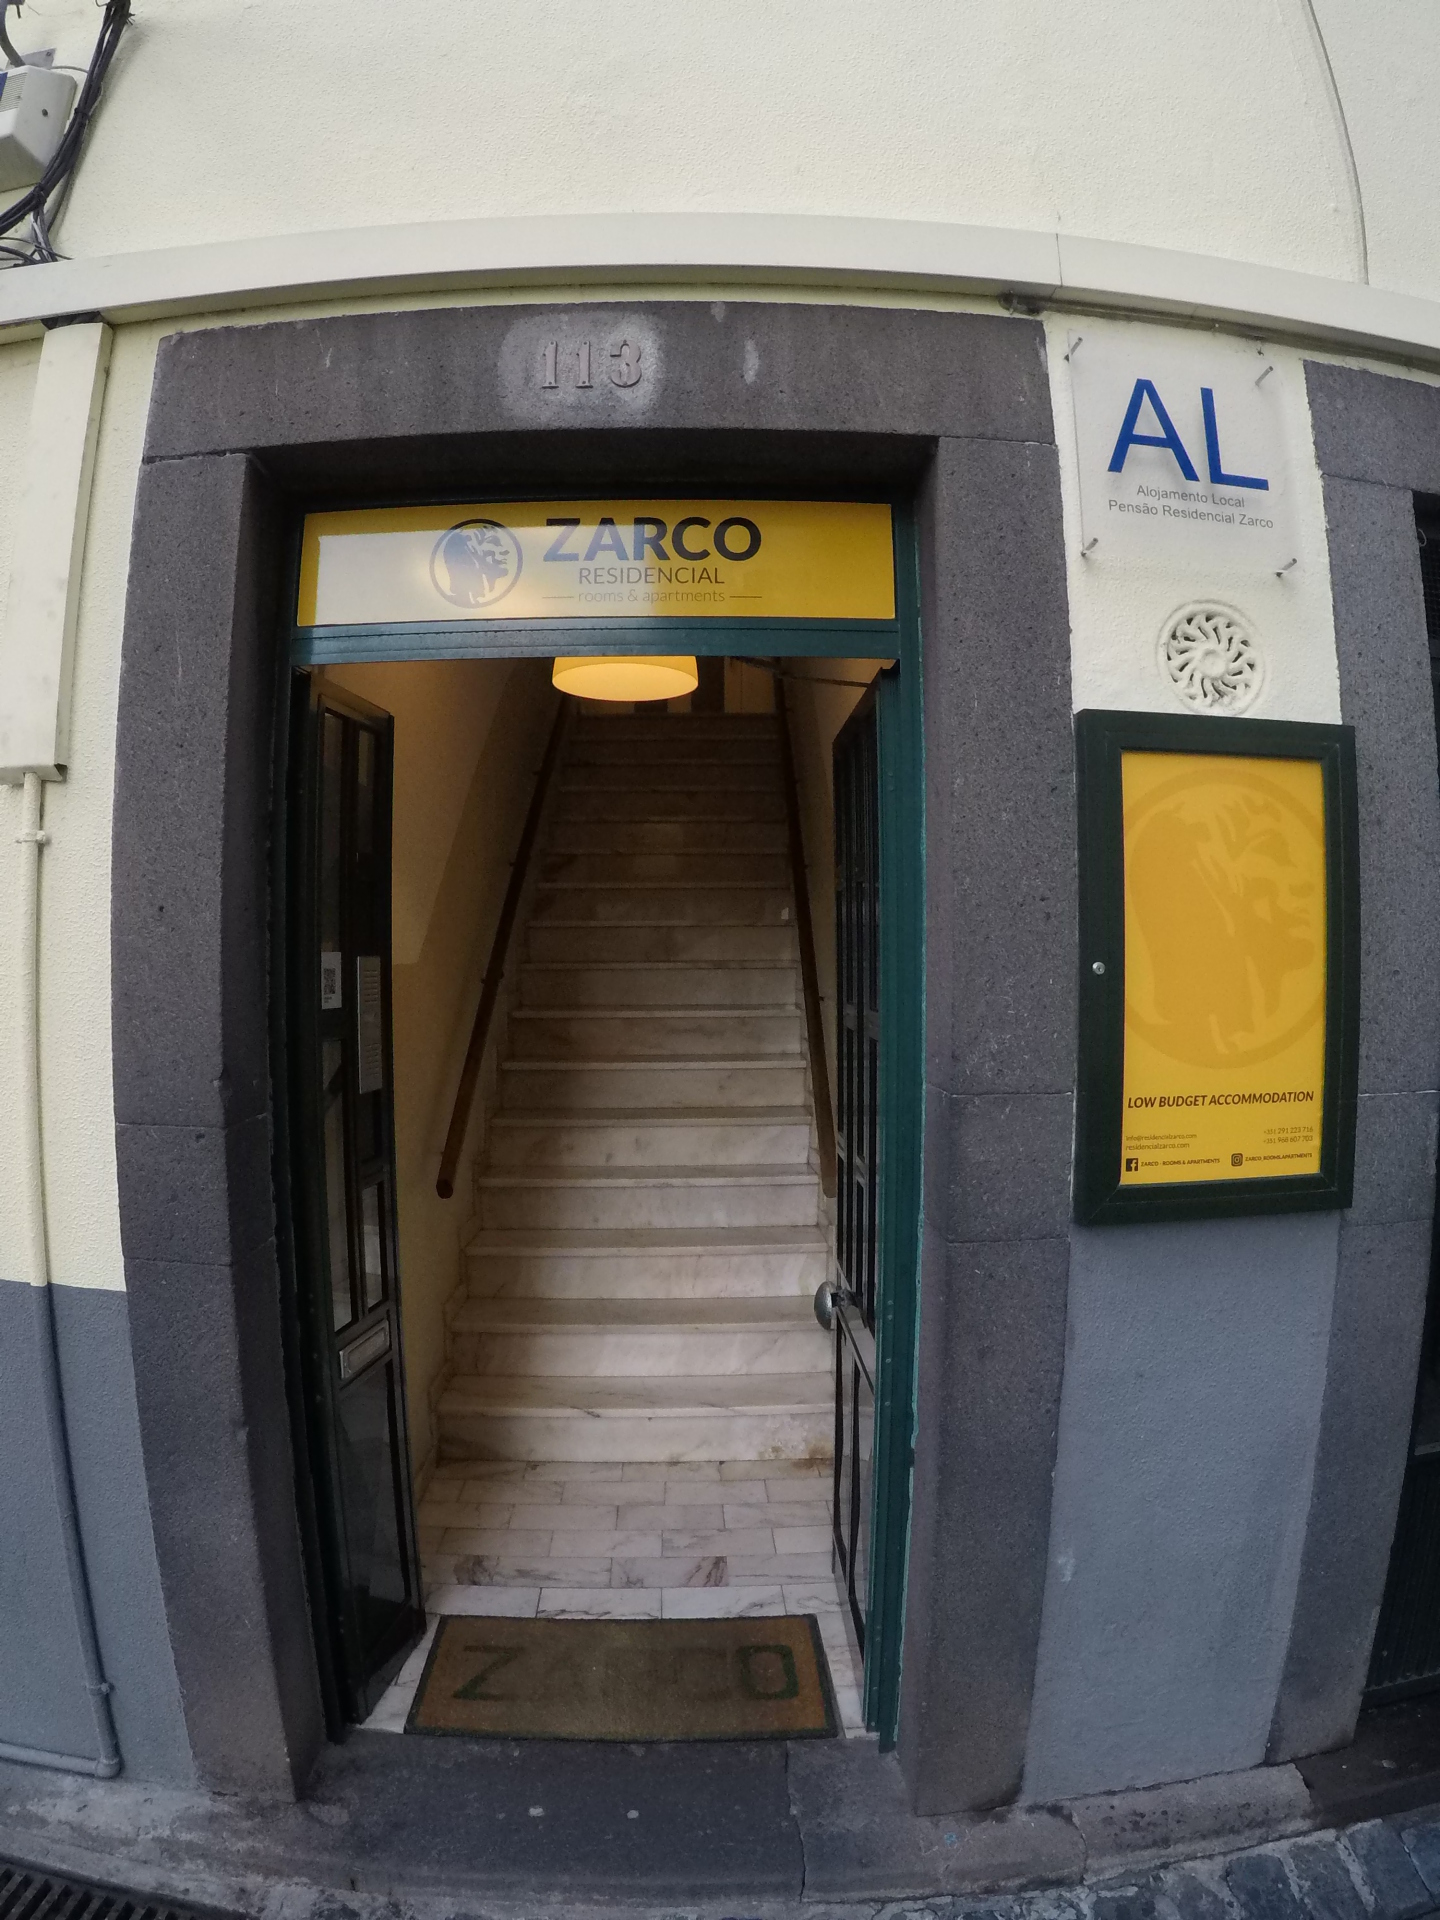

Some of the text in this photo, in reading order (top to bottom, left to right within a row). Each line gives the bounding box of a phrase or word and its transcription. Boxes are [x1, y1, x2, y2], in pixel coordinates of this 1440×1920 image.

[541, 340, 642, 389] 113
[1107, 378, 1269, 491] AL
[1136, 485, 1245, 508] Alojamento Local
[1108, 500, 1274, 529] Pensão Residencial Zarco
[543, 516, 762, 562] ZARCO
[578, 566, 725, 585] RESIDENCIAL
[578, 588, 725, 604] rooms & apartments
[1127, 1090, 1315, 1109] LOW BUDGET ACCOMMODATION
[1290, 1126, 1301, 1134] 223
[1302, 1125, 1314, 1133] 716
[1125, 1142, 1190, 1151] residencialzarco.com
[453, 1644, 800, 1701] ZCO
